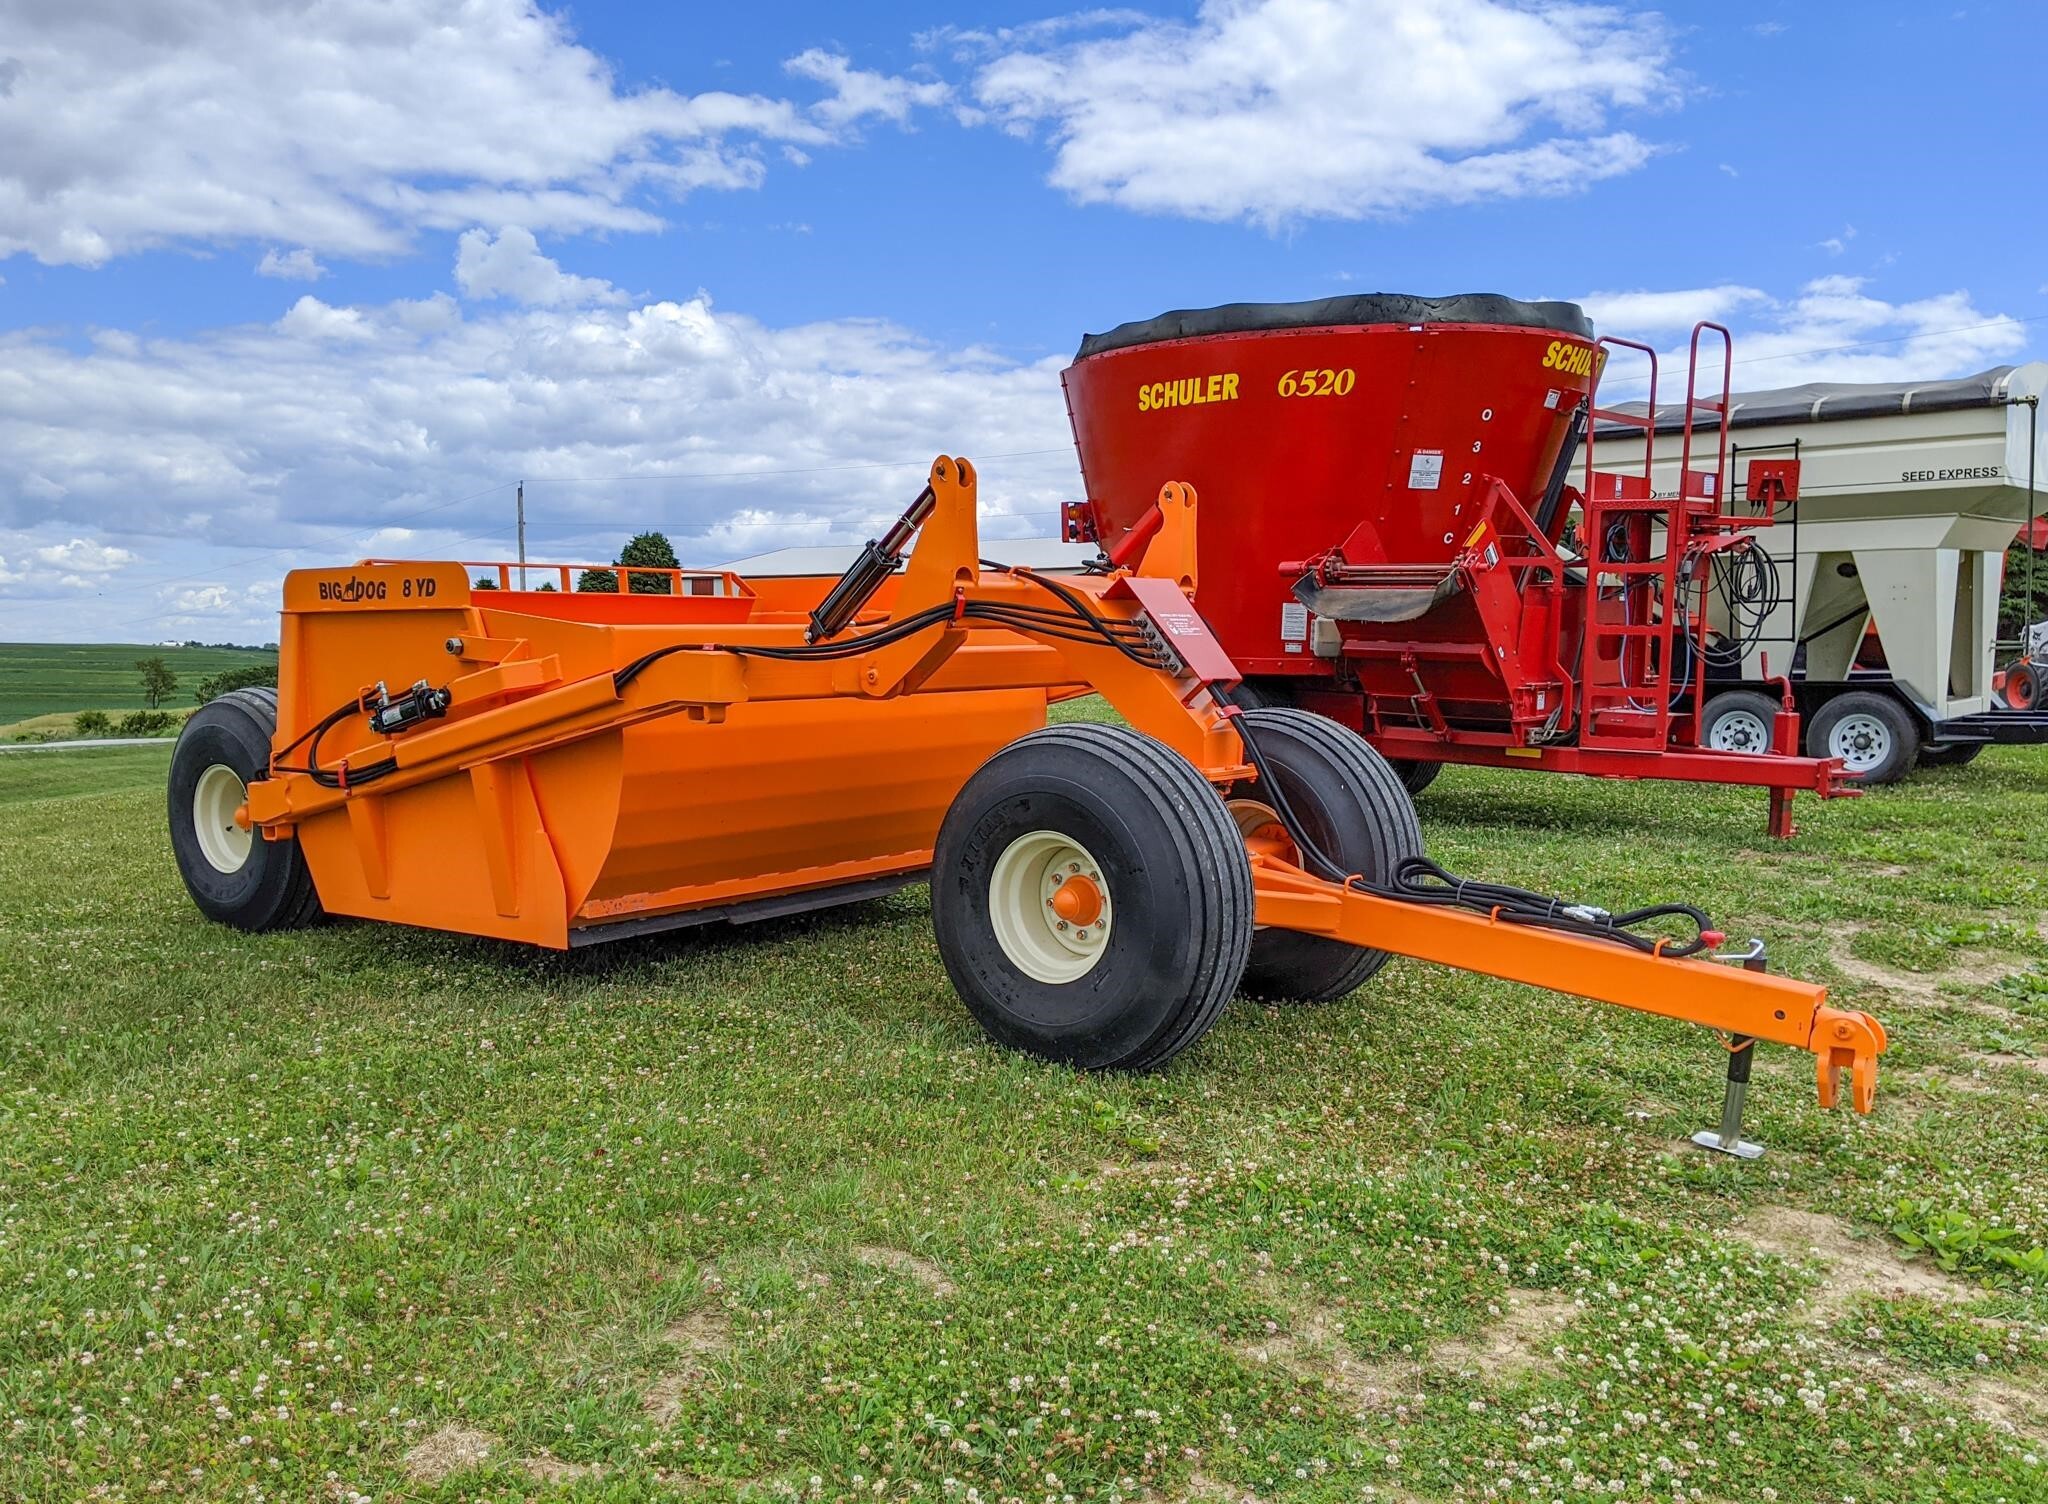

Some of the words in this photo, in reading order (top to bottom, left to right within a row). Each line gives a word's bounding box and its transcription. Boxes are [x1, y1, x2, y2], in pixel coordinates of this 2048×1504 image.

[1542, 341, 1606, 377] SCHUL
[1138, 373, 1240, 411] SCHULER
[1277, 368, 1356, 397] 6520
[1472, 440, 1482, 453] 3
[1462, 472, 1472, 485] 2
[1901, 470, 1935, 482] SEED
[1454, 504, 1461, 516] 1
[1443, 532, 1454, 544] C
[319, 582, 342, 600] BIG
[355, 580, 387, 600] DOG
[402, 579, 412, 598] 8
[415, 577, 437, 597] YD
